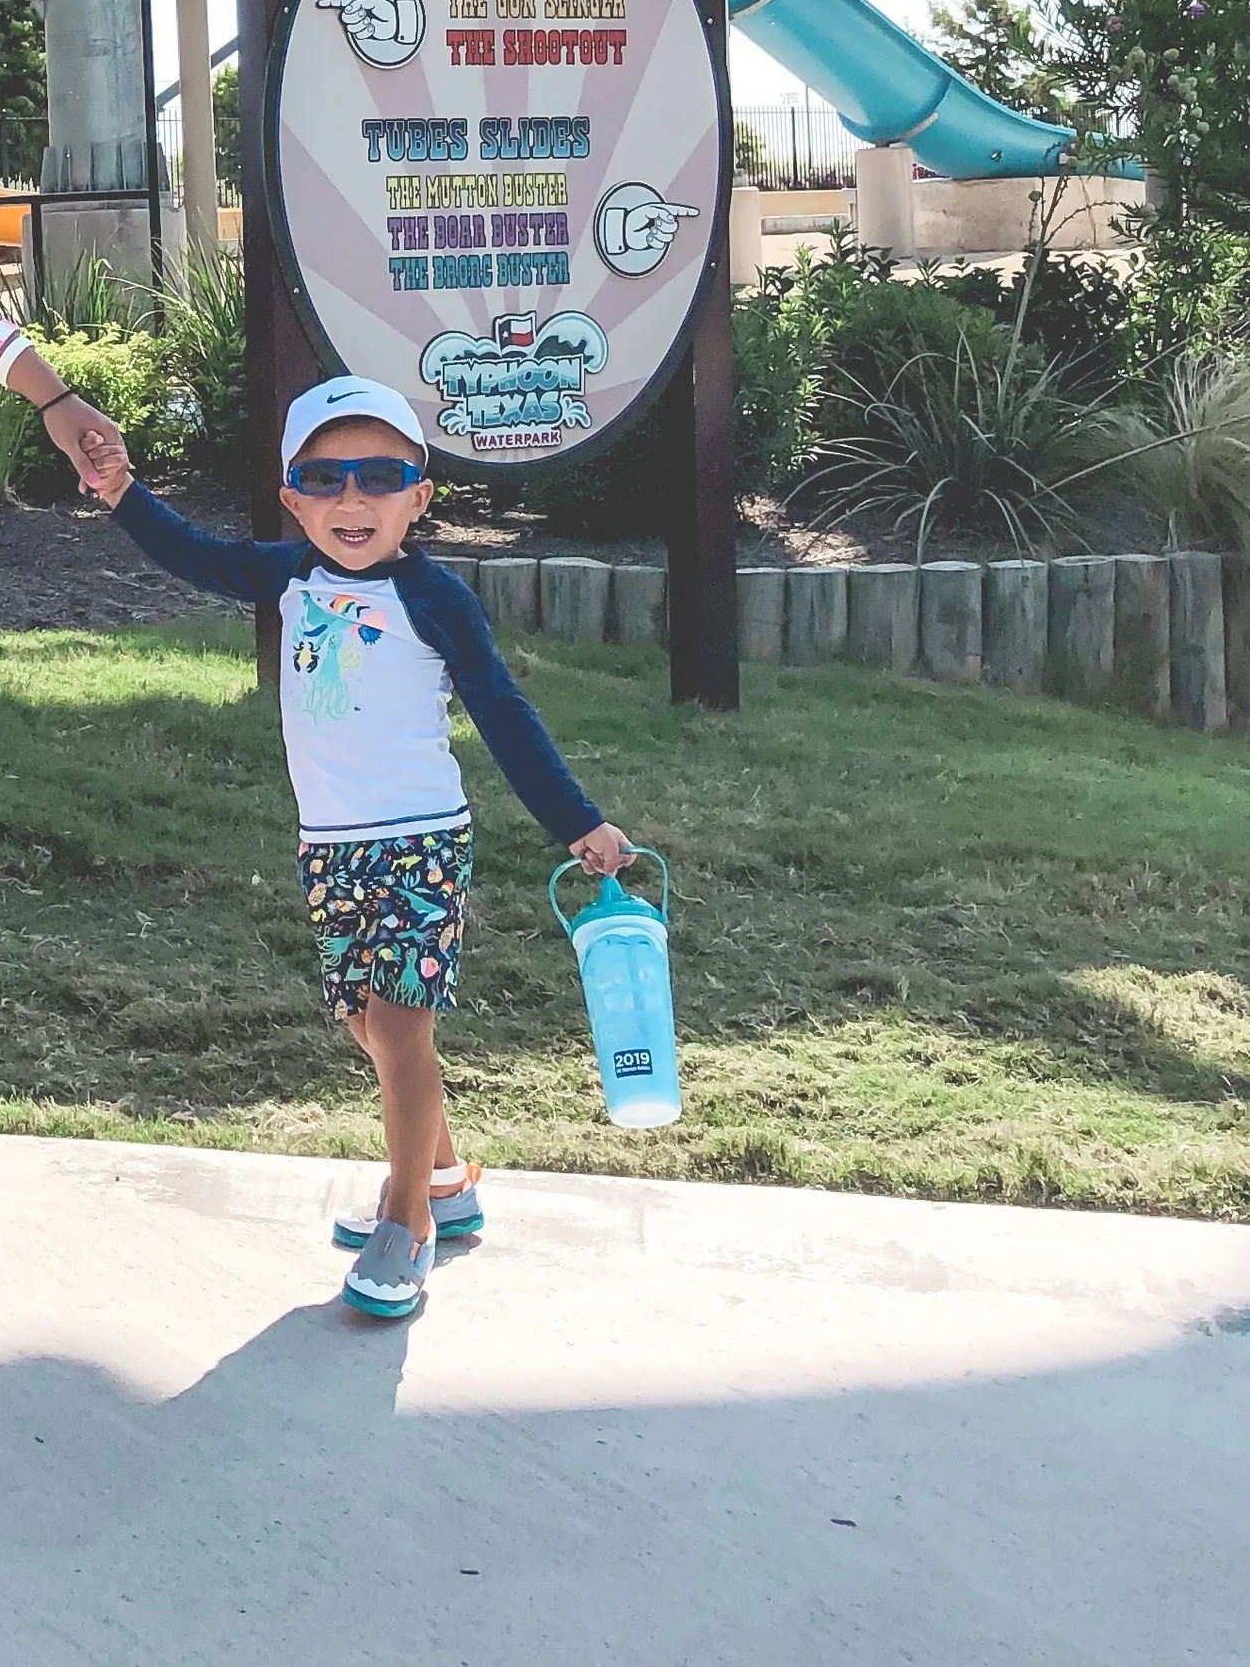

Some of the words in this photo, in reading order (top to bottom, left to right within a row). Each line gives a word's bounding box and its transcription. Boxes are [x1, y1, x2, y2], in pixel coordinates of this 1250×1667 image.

[446, 29, 496, 66] THE
[503, 29, 627, 66] SHOOTOUT
[362, 118, 468, 162] TUBES
[480, 117, 591, 160] SLIDES
[386, 176, 421, 210] THE
[426, 174, 499, 209] MUTTON
[502, 173, 569, 207] BUSTER
[387, 216, 429, 250] THE
[434, 214, 487, 249] BOAR
[491, 212, 569, 248] BUSTER
[389, 257, 429, 291] THE
[432, 254, 493, 290] BRONC
[496, 251, 570, 288] BUSTER
[444, 358, 580, 395] TYPHOON
[467, 391, 562, 427] TEXAS
[475, 432, 560, 447] WATERPARK
[615, 1052, 650, 1068] 2019
